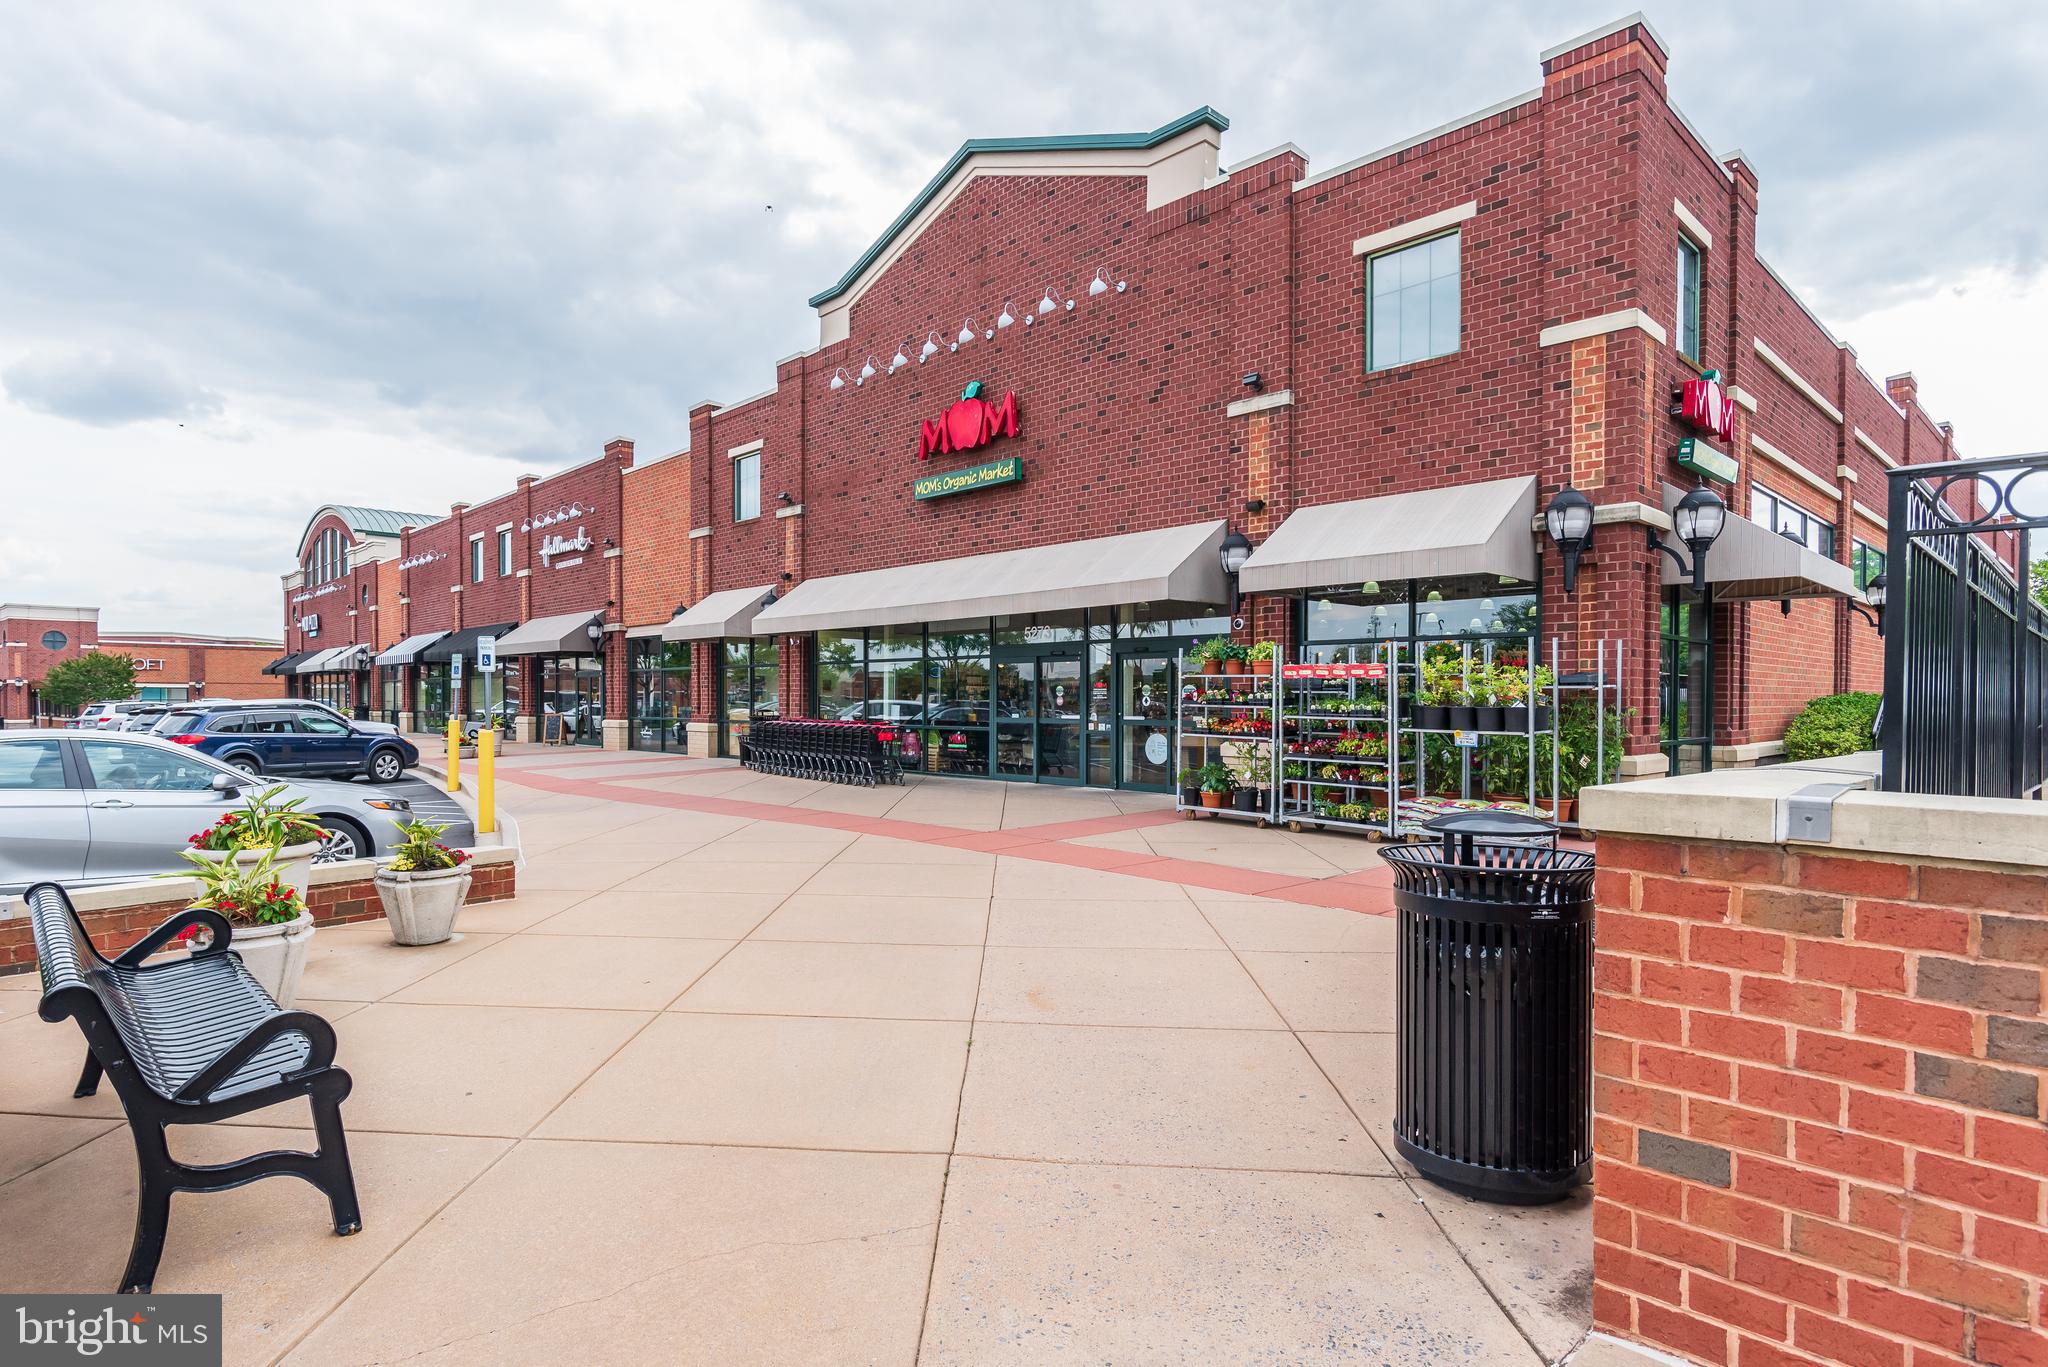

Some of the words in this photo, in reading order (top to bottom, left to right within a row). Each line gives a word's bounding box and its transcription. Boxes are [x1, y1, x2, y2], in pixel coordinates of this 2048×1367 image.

[918, 389, 1021, 460] MOM
[915, 477, 942, 496] MOM's
[943, 471, 977, 490] Organic
[978, 460, 1014, 483] Market
[538, 526, 594, 568] Hallmark
